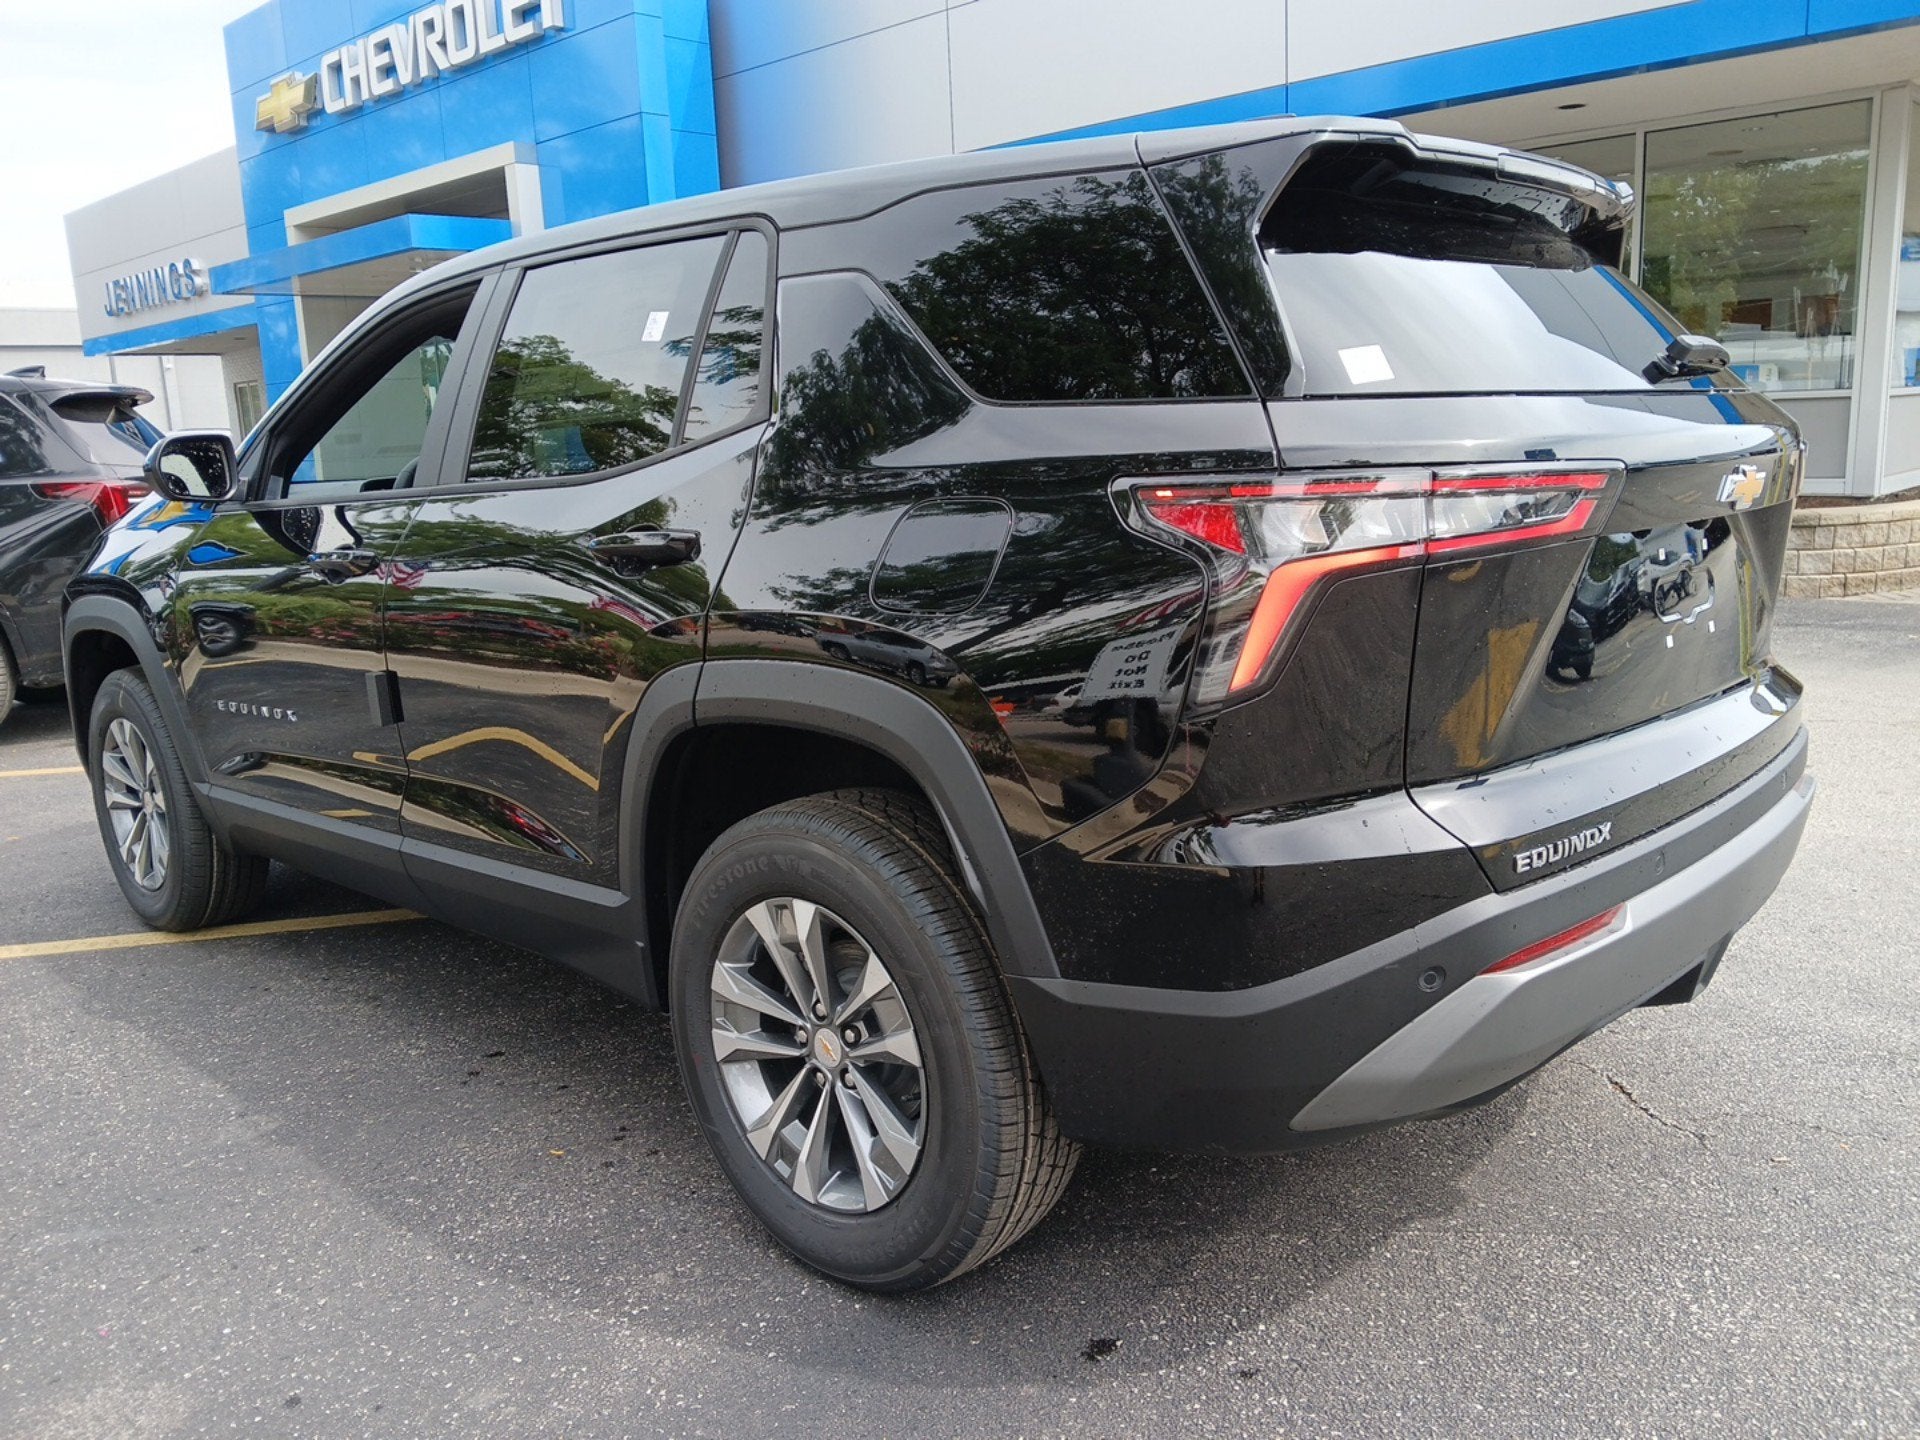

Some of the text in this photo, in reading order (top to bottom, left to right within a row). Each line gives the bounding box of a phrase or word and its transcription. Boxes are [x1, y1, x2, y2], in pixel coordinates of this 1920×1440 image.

[104, 258, 200, 317] JENNINGS
[217, 699, 298, 722] EQUINOX
[1513, 822, 1612, 873] EQUINOX
